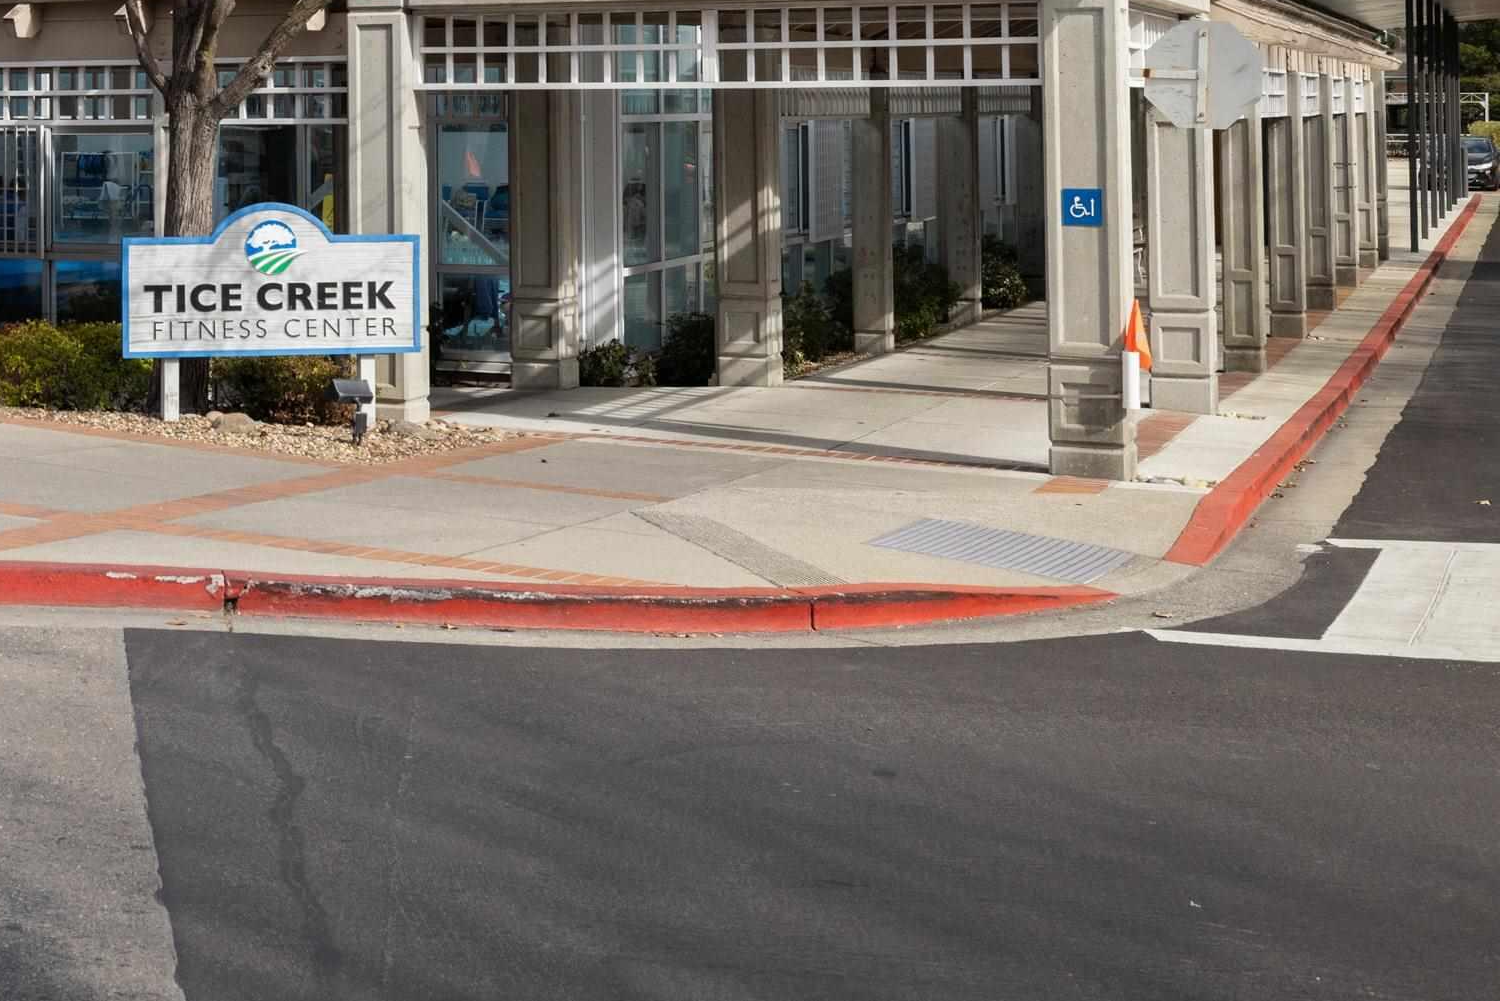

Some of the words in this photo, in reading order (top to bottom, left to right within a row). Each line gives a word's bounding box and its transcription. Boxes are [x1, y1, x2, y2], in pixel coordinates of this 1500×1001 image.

[143, 283, 243, 314] TICE
[256, 280, 397, 312] CREEK
[153, 319, 268, 341] FITNESS
[284, 317, 397, 338] CENTER
